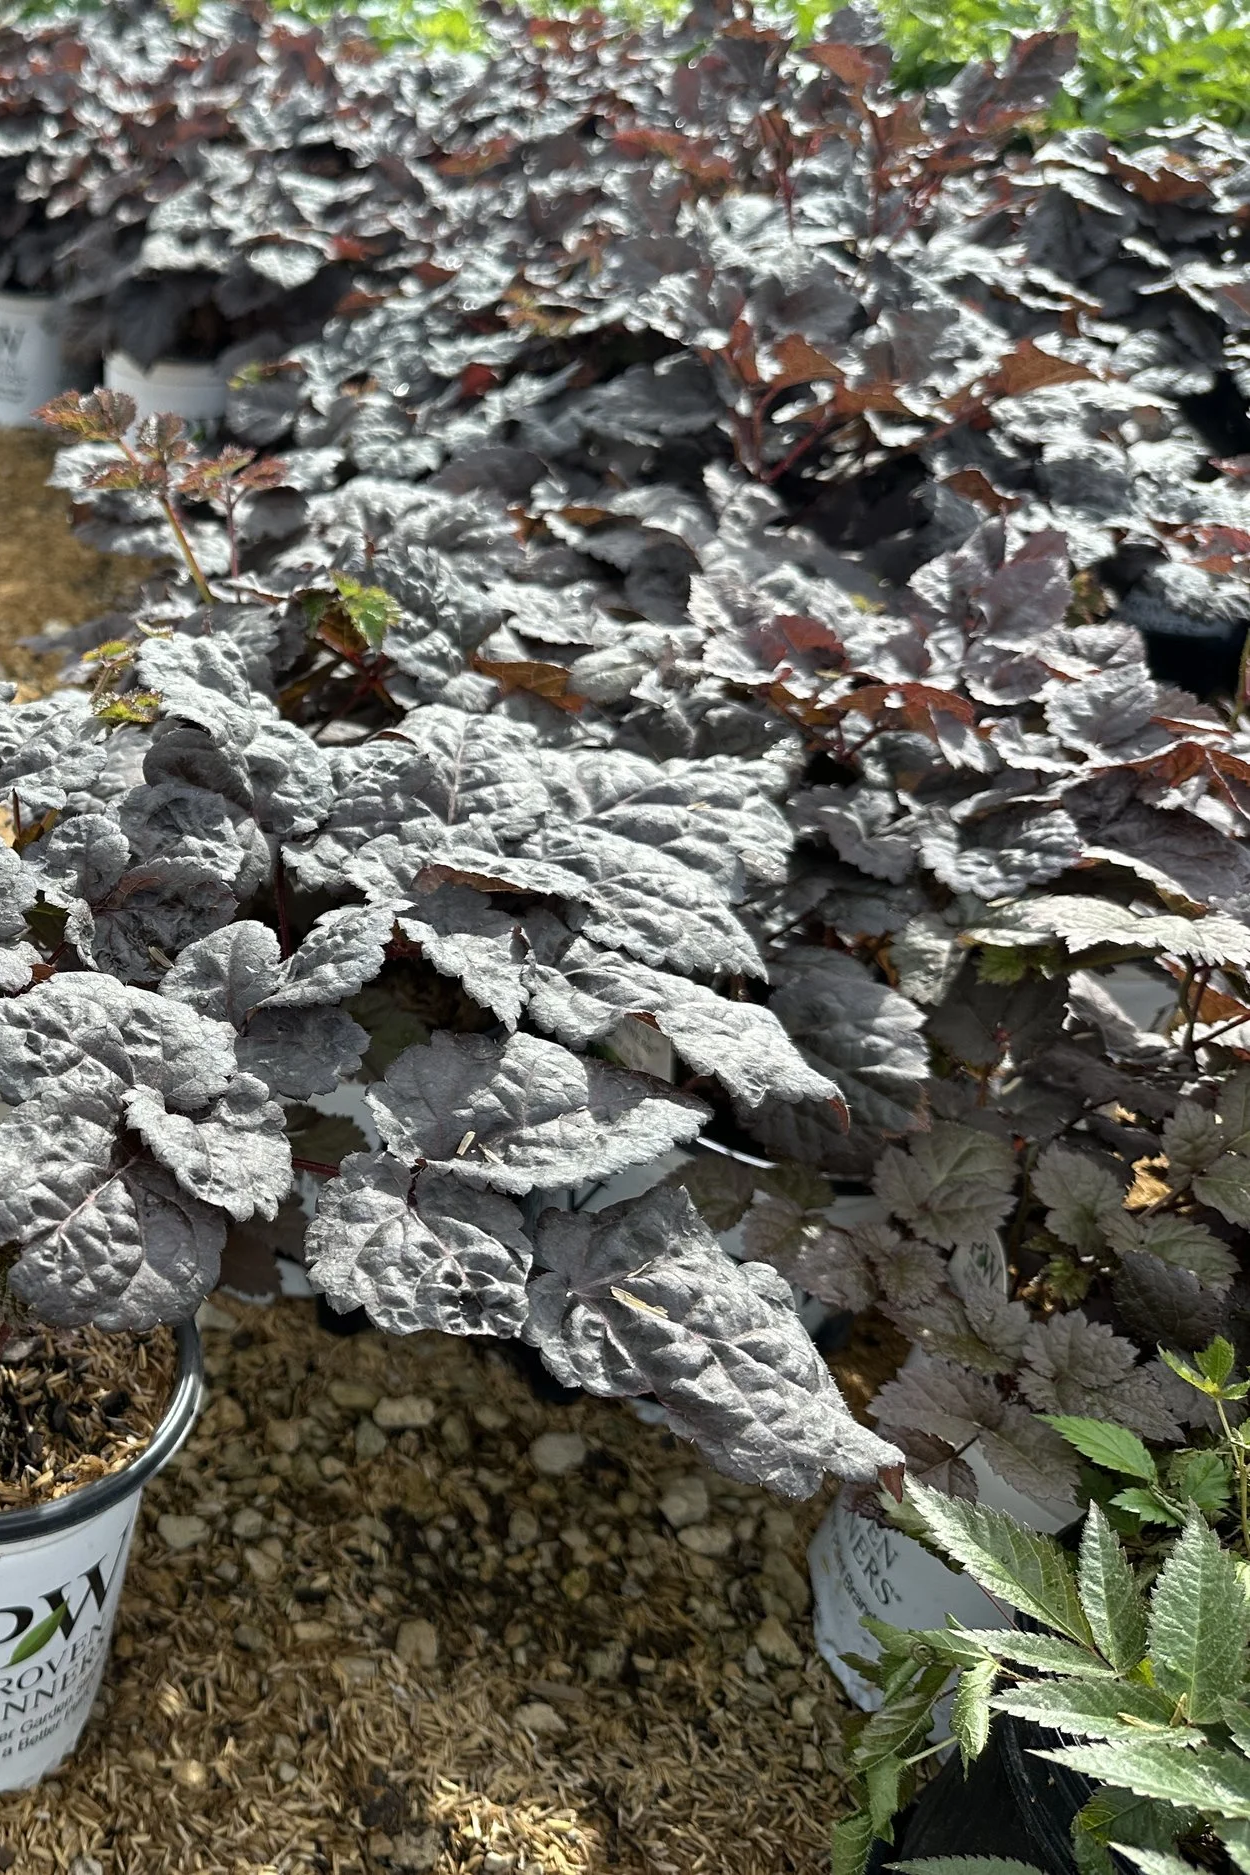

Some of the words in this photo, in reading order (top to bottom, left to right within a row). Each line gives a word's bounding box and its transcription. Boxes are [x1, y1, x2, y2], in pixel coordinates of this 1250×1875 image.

[20, 1694, 73, 1734] Garden
[2, 1746, 12, 1758] a
[17, 1720, 61, 1751] Better
